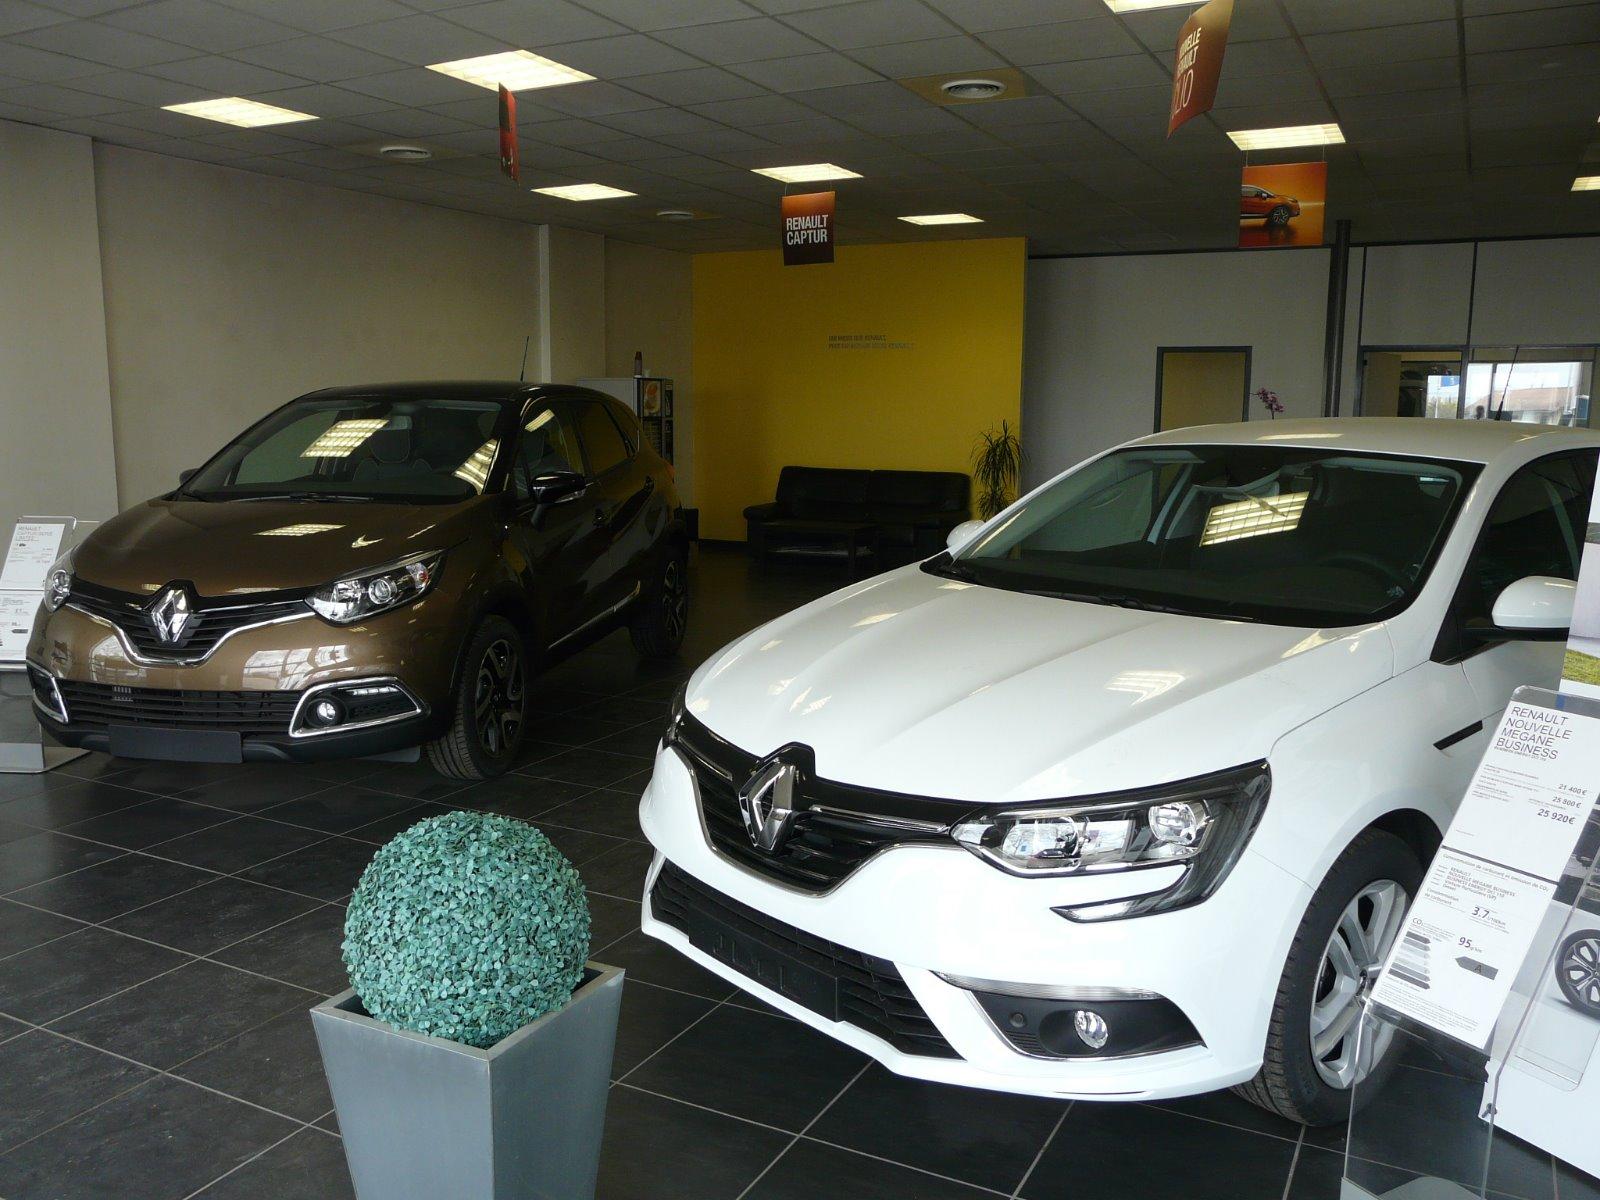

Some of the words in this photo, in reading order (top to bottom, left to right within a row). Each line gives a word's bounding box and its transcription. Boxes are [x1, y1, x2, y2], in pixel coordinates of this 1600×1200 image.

[786, 214, 829, 231] RENAULT
[786, 228, 828, 246] CAPTUR
[1511, 706, 1569, 726] RENAULT
[1501, 727, 1555, 747] MEGANE
[1505, 717, 1573, 740] NOUVELLE
[1496, 737, 1559, 760] BUSINESS
[1558, 783, 1567, 791] 21
[1568, 786, 1582, 795] 400
[1537, 808, 1551, 818] 25
[1458, 936, 1472, 948] 95
